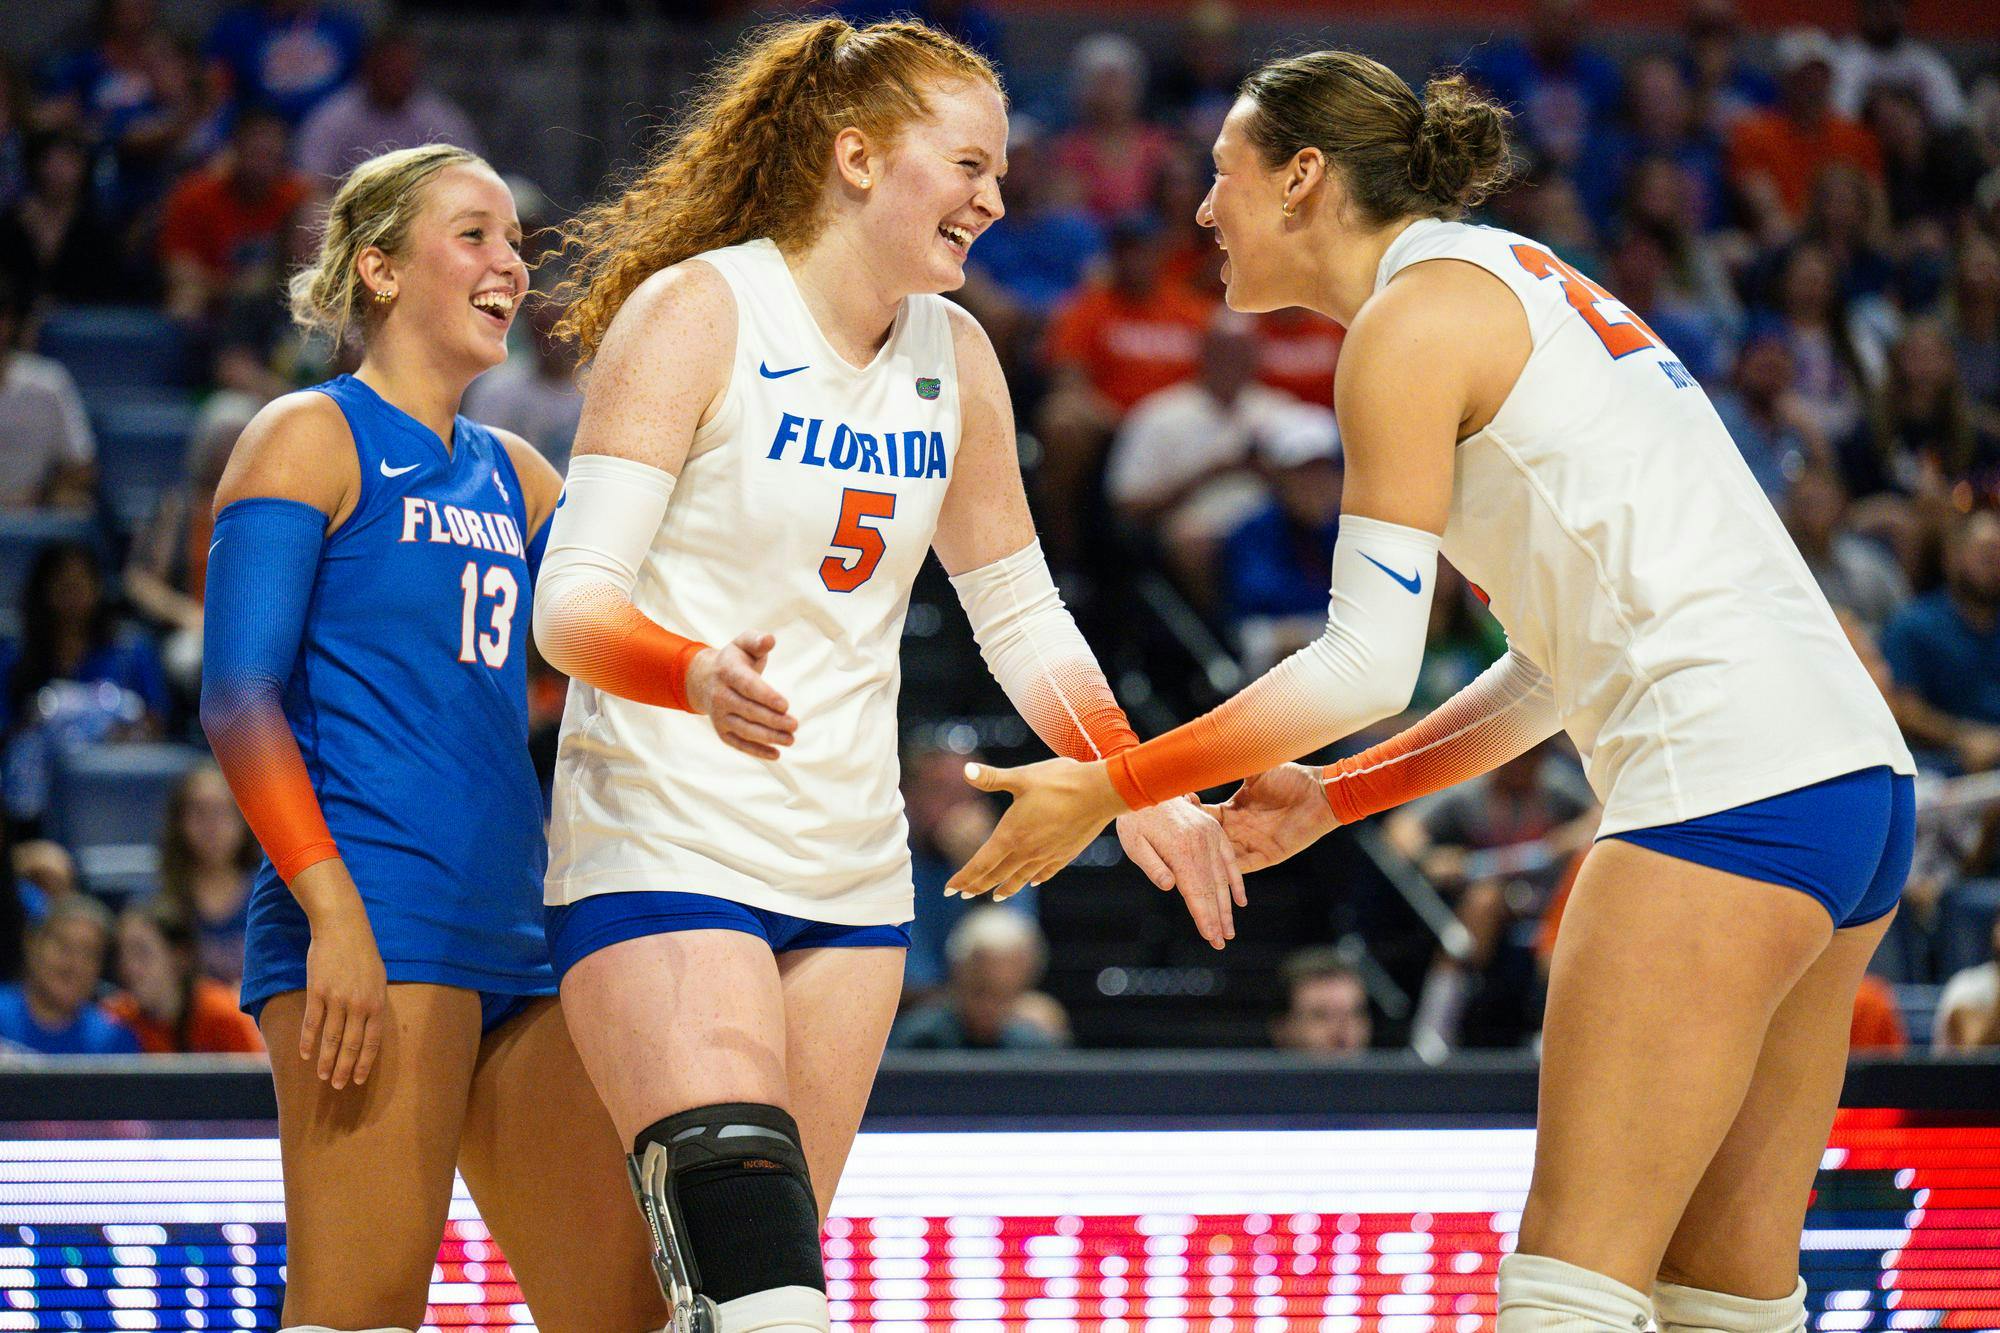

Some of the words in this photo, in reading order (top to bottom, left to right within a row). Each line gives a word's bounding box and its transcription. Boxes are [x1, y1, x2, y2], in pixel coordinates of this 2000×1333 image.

[766, 412, 947, 479] FLORIDA
[818, 487, 897, 593] 5
[458, 561, 519, 669] 13
